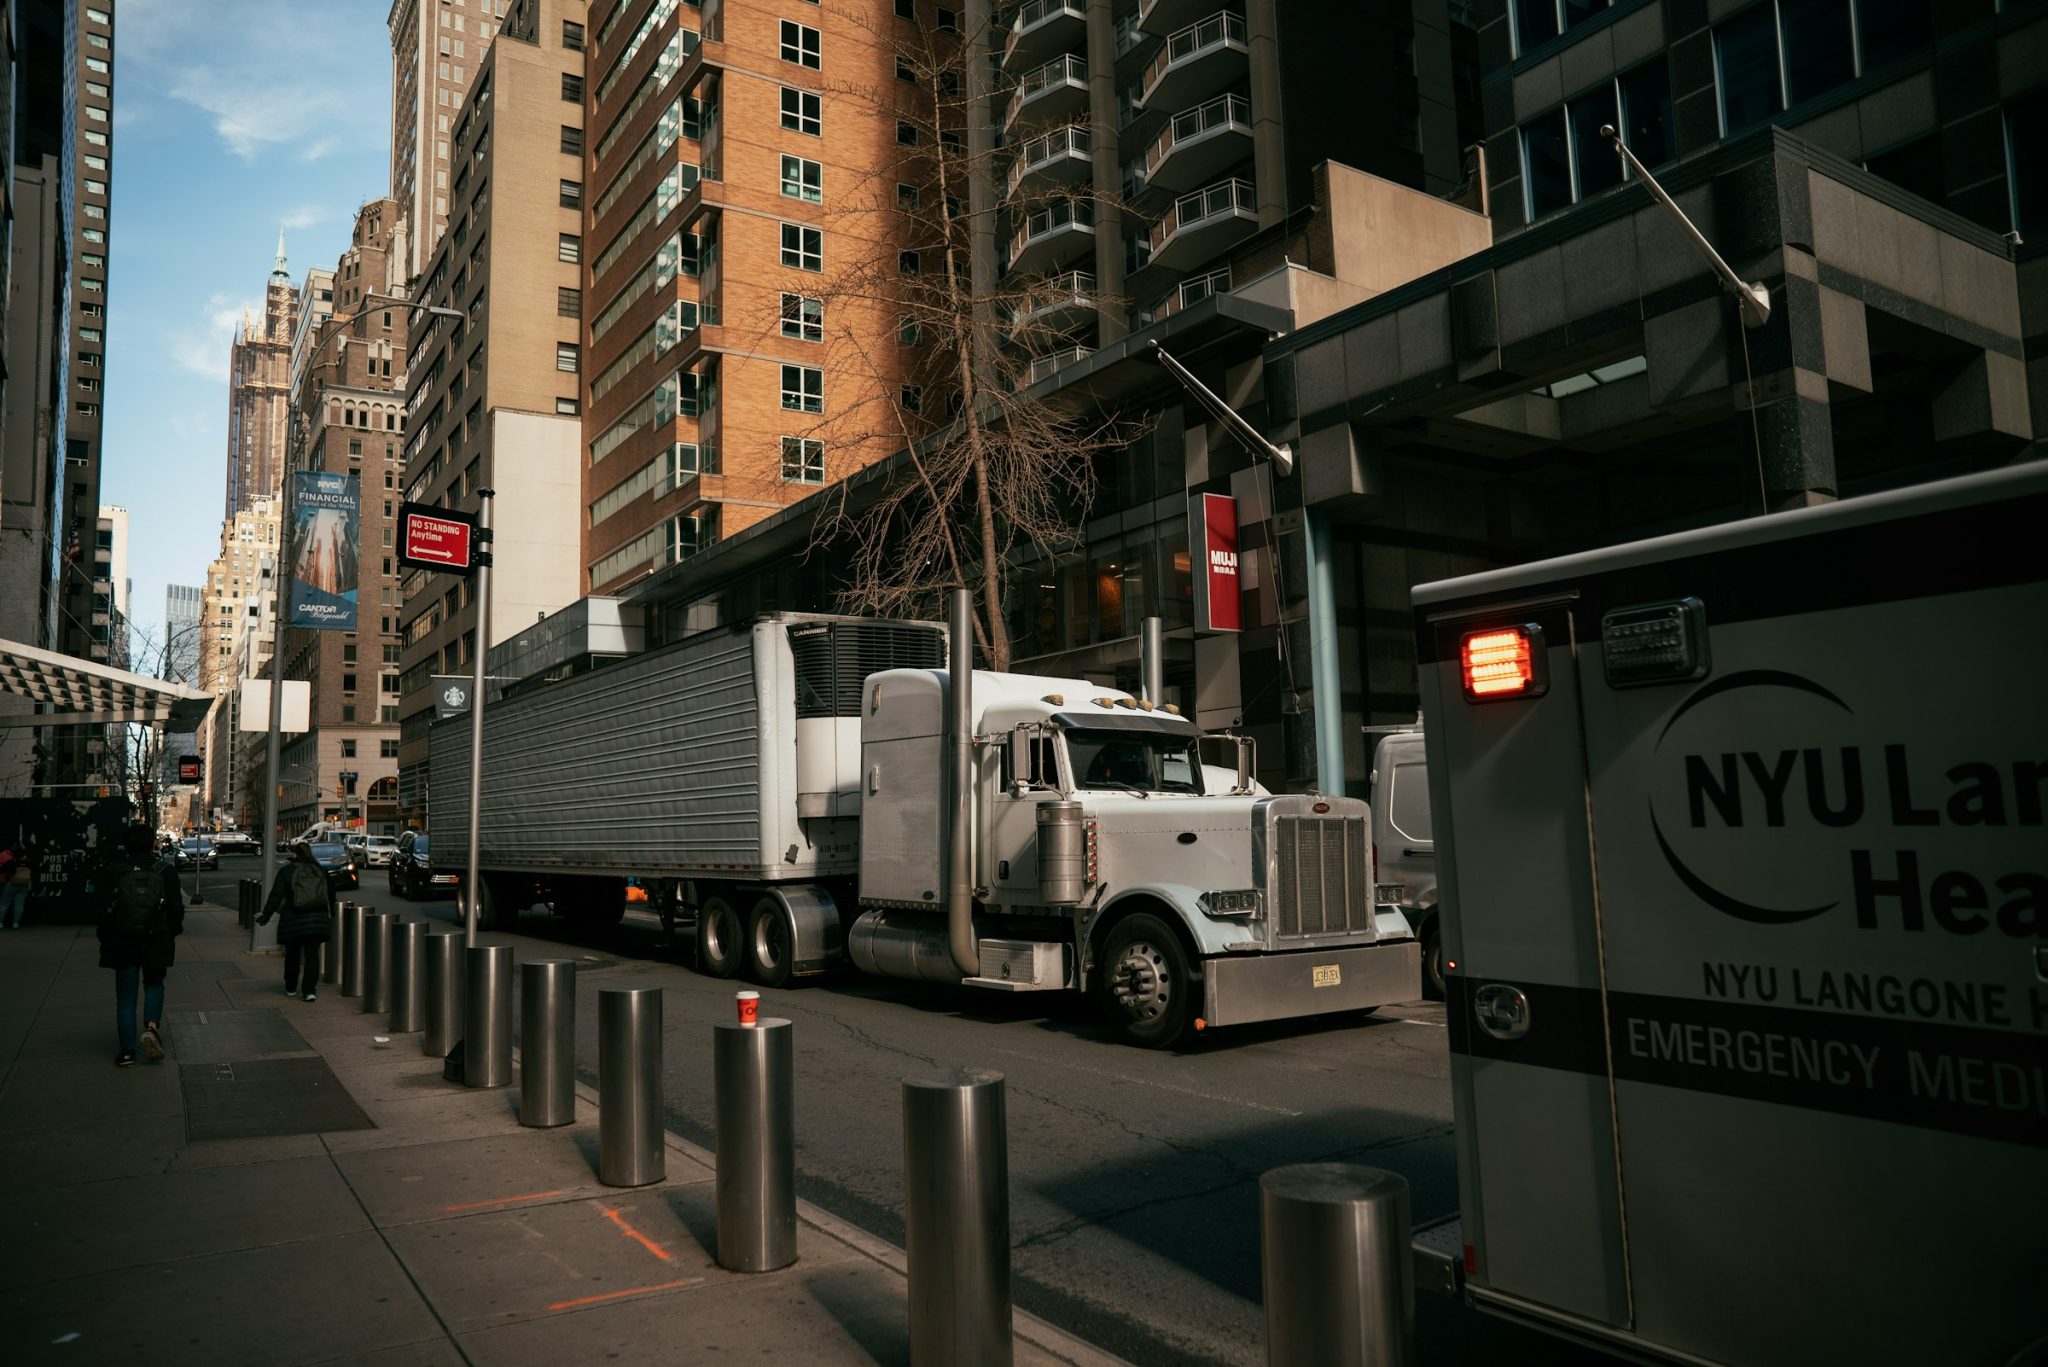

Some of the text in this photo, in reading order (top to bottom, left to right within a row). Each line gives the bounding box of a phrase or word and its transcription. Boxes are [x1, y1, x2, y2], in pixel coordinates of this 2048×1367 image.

[299, 492, 355, 504] FINANCIAL
[411, 519, 460, 535] NO STANDING
[411, 530, 443, 542] Anytime
[1211, 550, 1238, 567] MUJI
[298, 604, 337, 613] CANTOR
[309, 611, 350, 621] Fitzgerald
[1684, 744, 2048, 827] NYU Lan
[43, 854, 69, 864] POST
[49, 864, 62, 873] NO
[40, 872, 69, 883] BILLS
[1850, 849, 2048, 940] Hea
[1703, 961, 1778, 1002] NYU
[1793, 968, 2011, 1026] LANGONE
[1626, 1016, 2048, 1118] EMERGENCY MEDI
